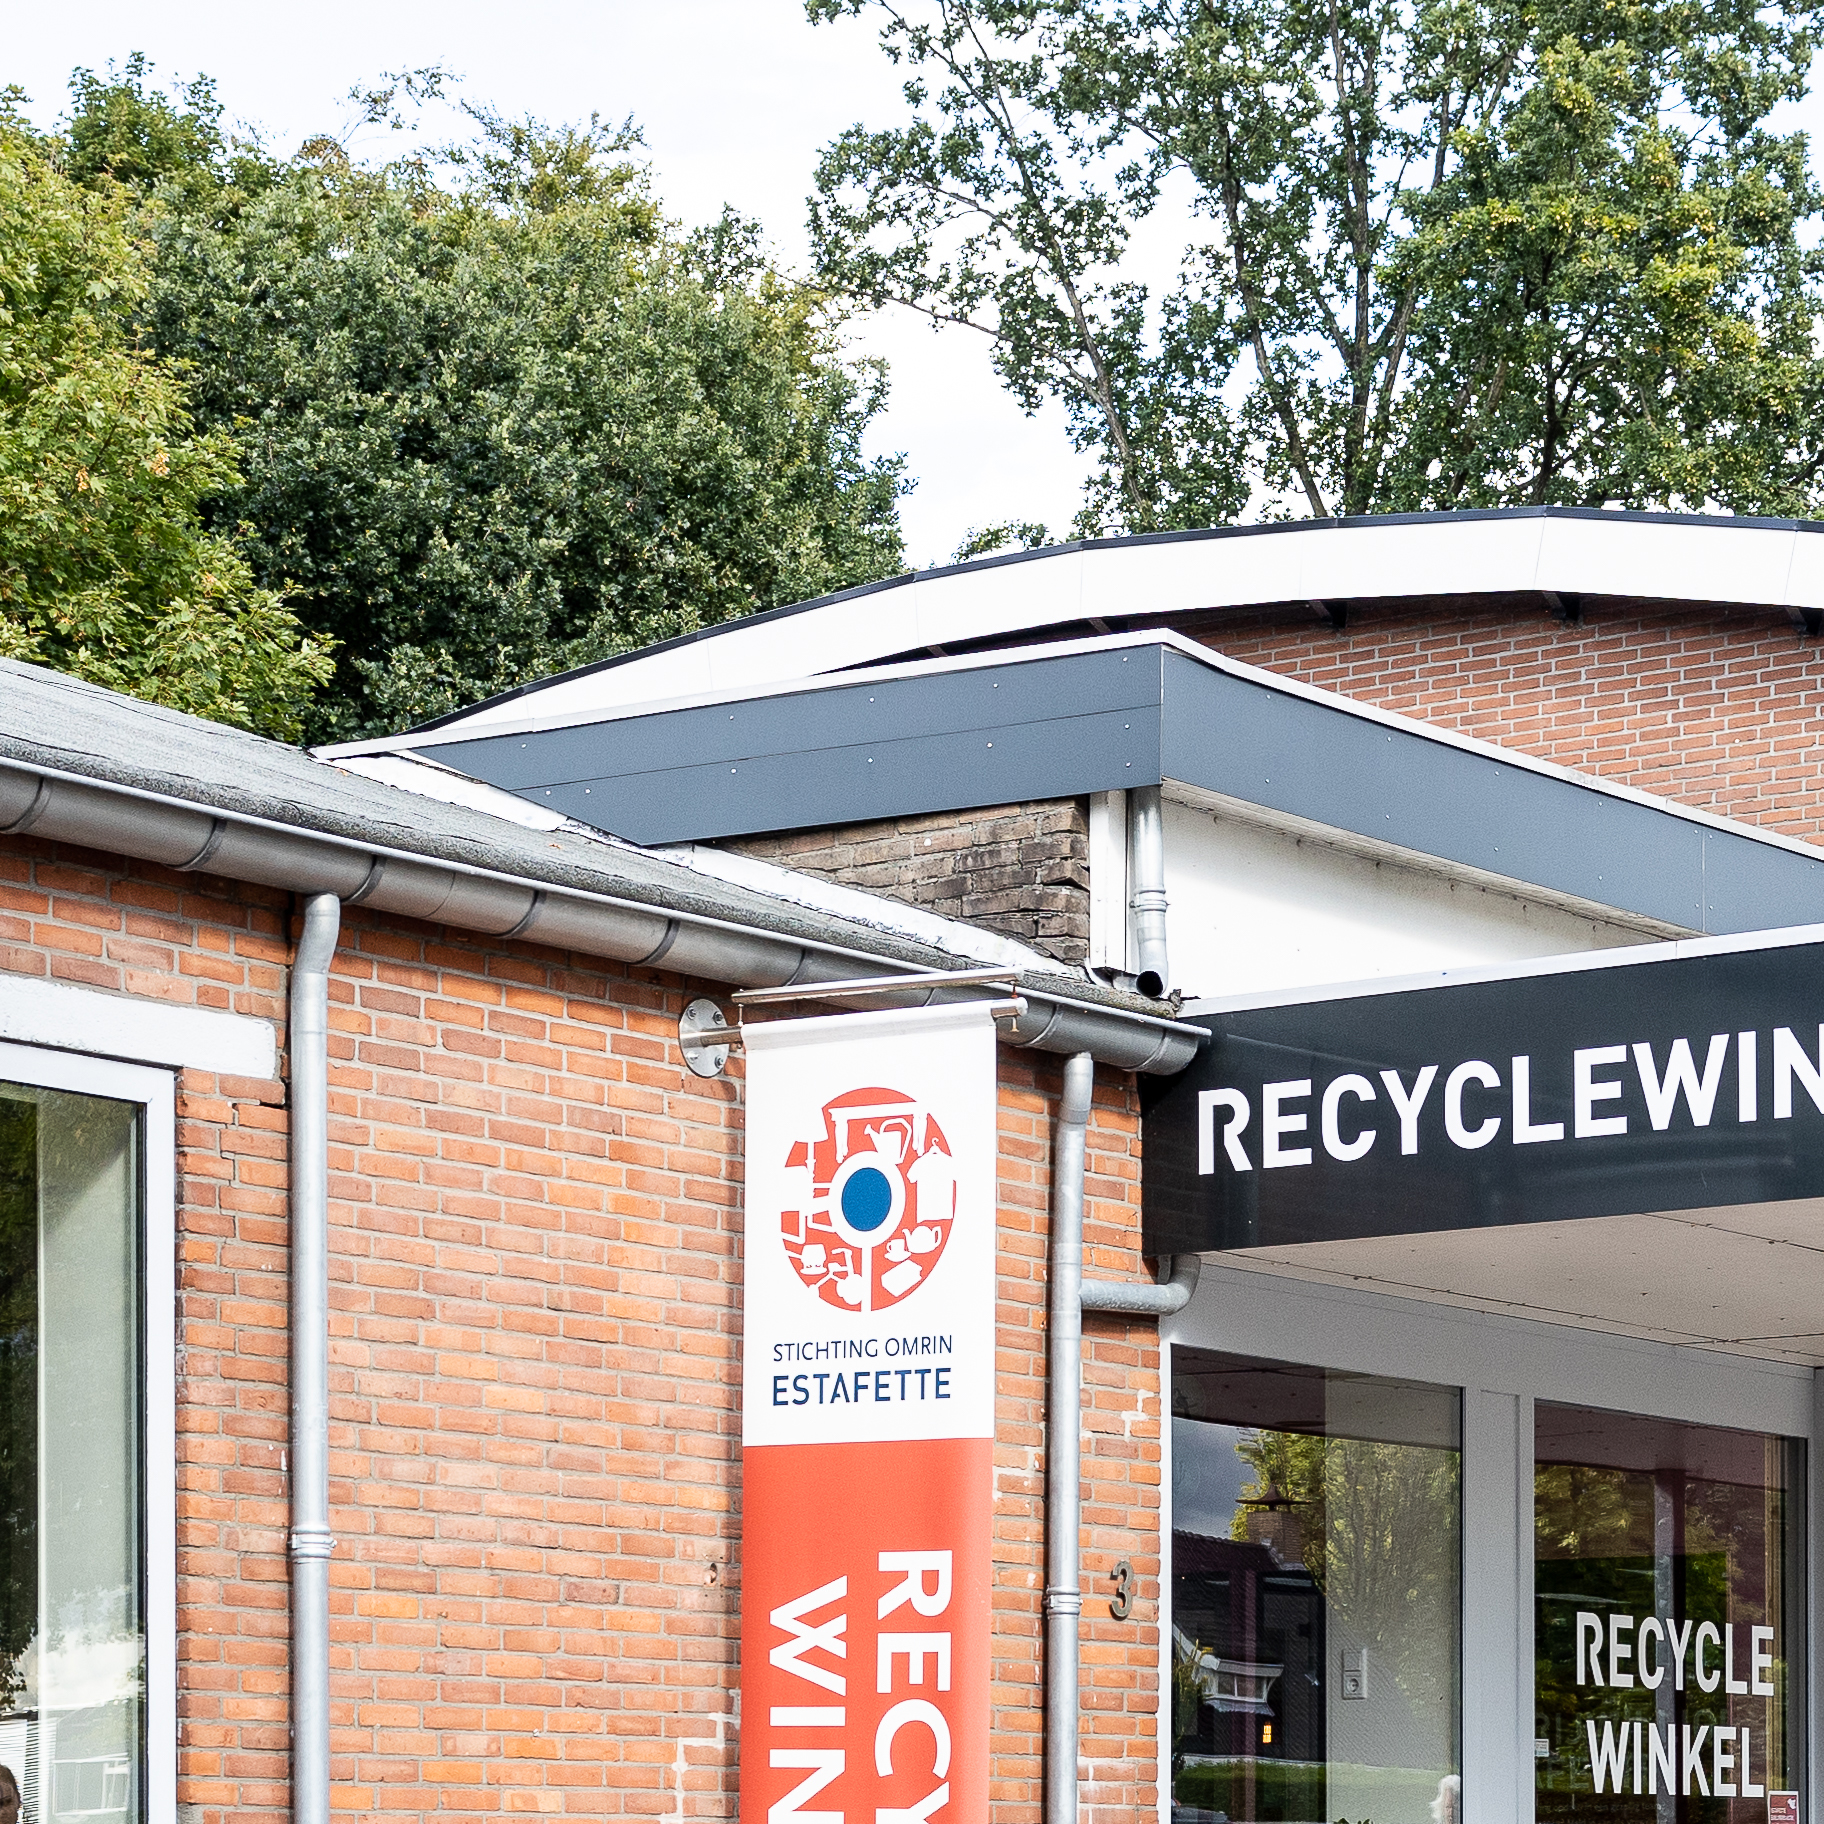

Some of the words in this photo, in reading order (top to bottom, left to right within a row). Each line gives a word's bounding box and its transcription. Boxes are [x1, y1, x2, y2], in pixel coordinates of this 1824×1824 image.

[773, 1339, 878, 1362] STICHTING
[884, 1334, 953, 1359] OMRIN
[772, 1367, 952, 1407] ESTAFETTE
[1110, 1560, 1135, 1618] 3
[1576, 1611, 1775, 1697] RECYCLE
[1585, 1719, 1765, 1798] WINKEL
